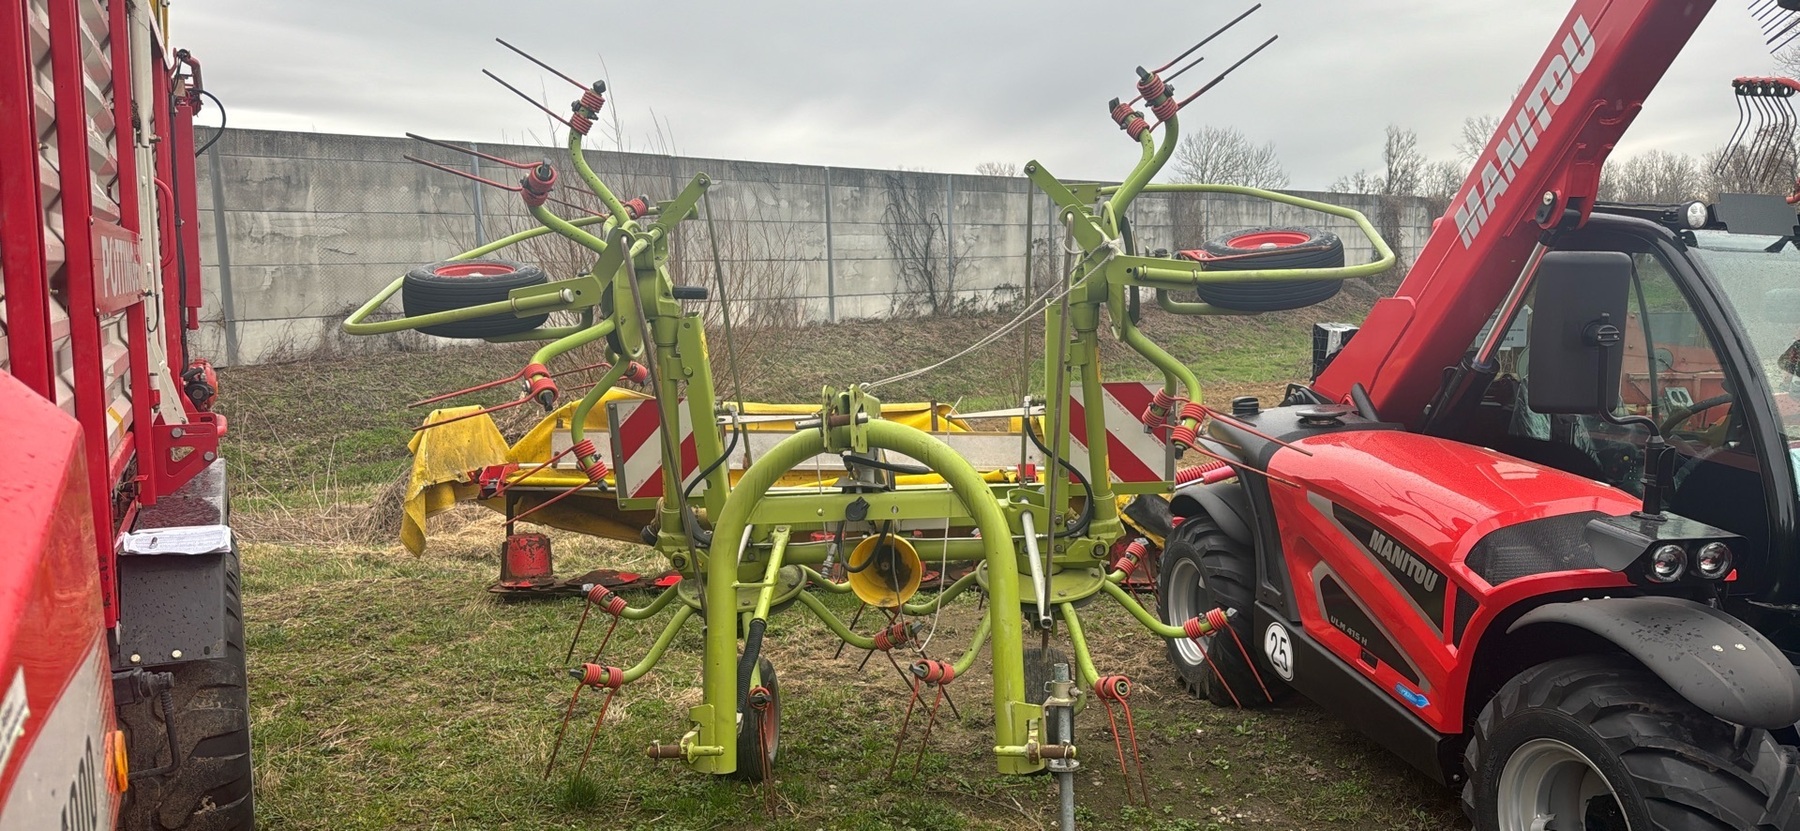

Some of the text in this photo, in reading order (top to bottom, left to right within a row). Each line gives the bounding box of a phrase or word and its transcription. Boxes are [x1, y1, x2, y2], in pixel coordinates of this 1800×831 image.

[1454, 14, 1596, 250] MANITOU
[1369, 529, 1439, 592] MANITOU
[1270, 632, 1288, 672] 25
[1330, 615, 1368, 646] ULM 415 H
